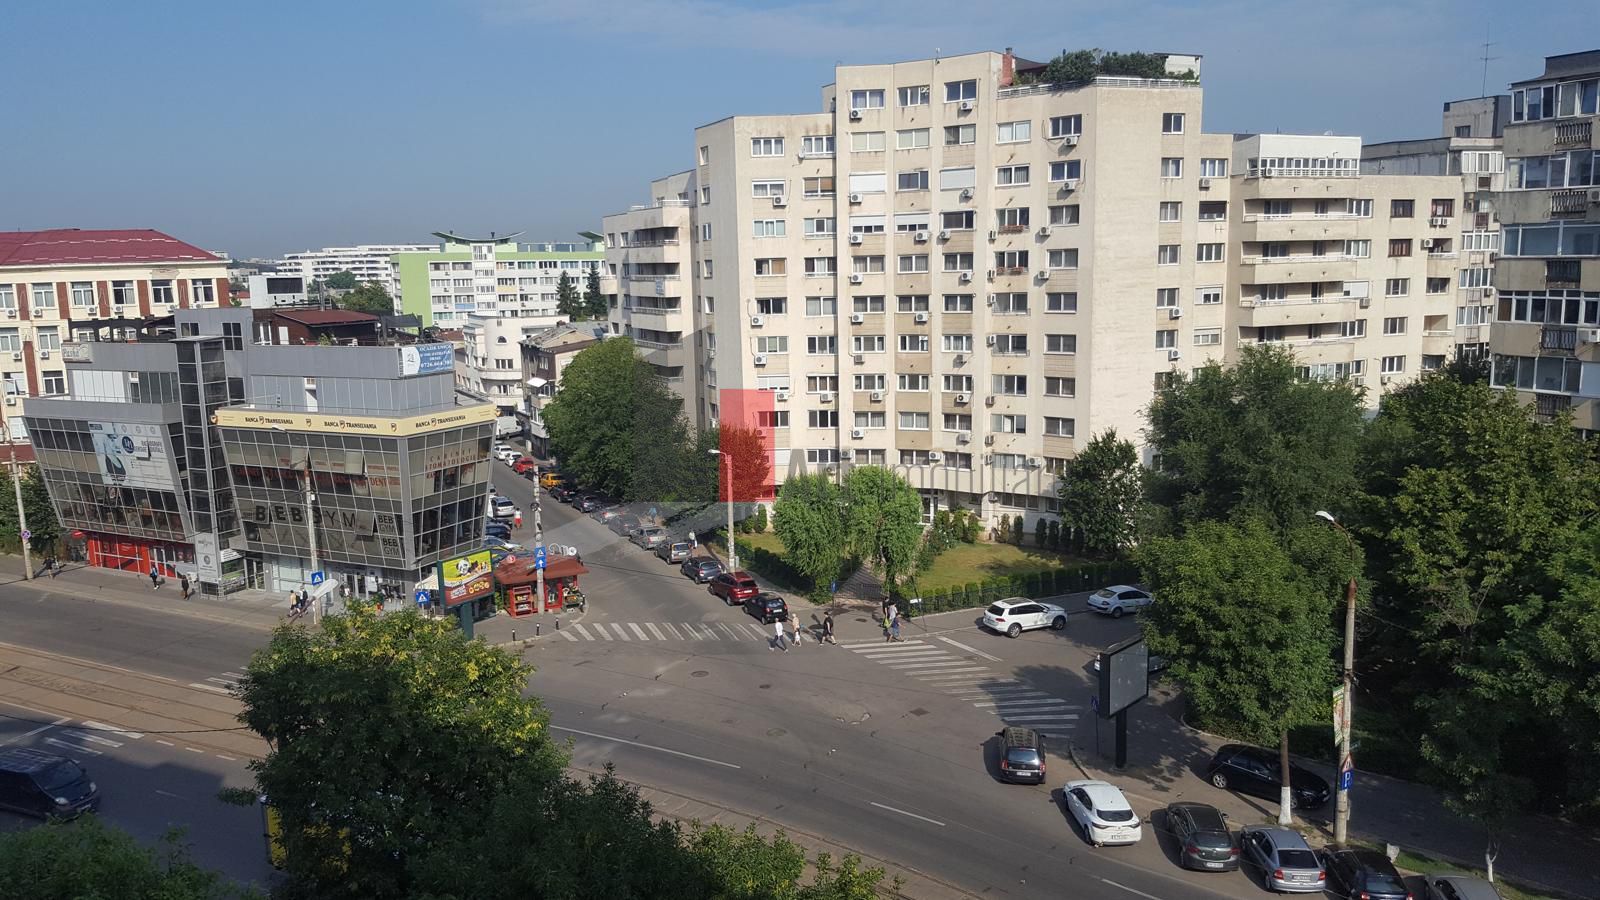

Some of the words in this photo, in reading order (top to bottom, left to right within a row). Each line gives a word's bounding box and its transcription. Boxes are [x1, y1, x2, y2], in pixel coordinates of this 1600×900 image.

[437, 415, 466, 425] TRANSILVANIA
[255, 505, 302, 522] BEB
[378, 514, 394, 523] BEB
[379, 524, 395, 533] GYM
[383, 538, 399, 547] BEB
[384, 547, 400, 556] GYM
